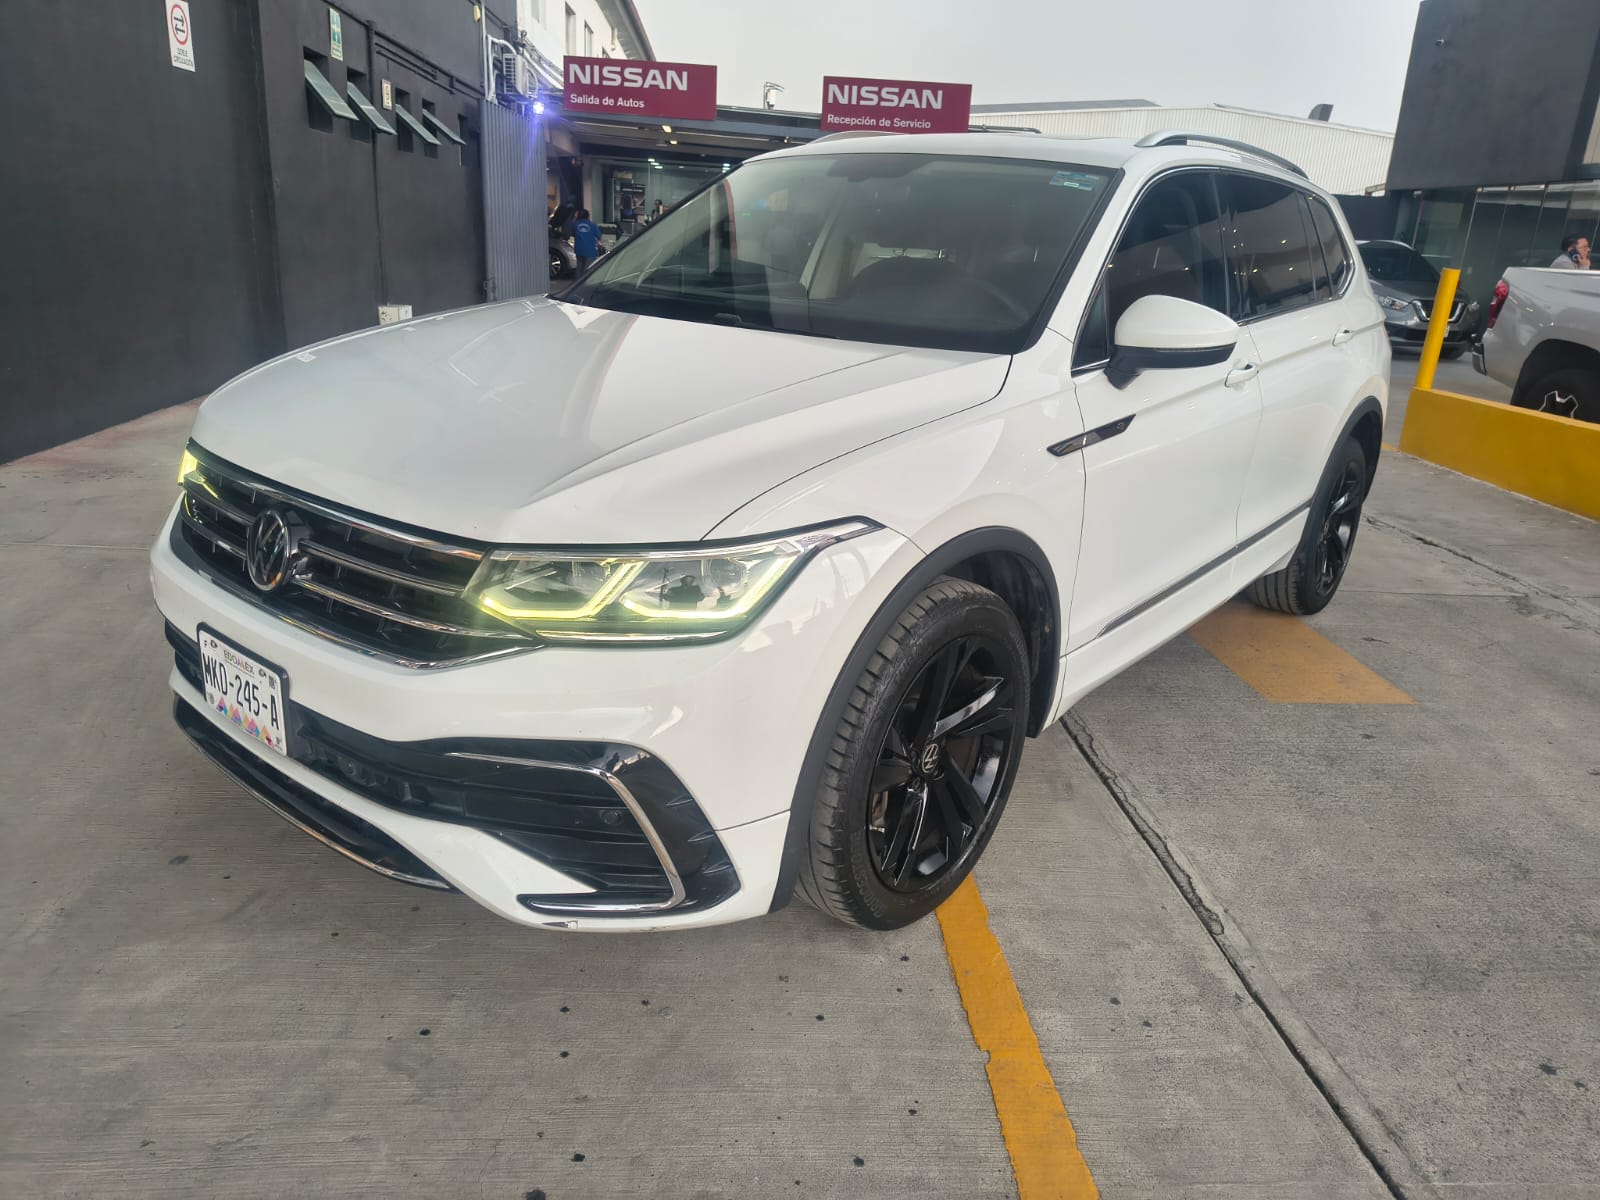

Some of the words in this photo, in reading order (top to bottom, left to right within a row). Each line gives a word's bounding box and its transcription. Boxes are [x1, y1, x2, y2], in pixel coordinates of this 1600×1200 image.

[569, 63, 688, 91] NISSAN
[570, 93, 600, 105] Salida
[602, 96, 615, 106] de
[617, 97, 645, 108] Autos
[827, 83, 943, 110] NISSAN
[827, 114, 876, 127] Recepción
[879, 117, 891, 127] de
[893, 117, 931, 129] Servicio
[202, 652, 280, 731] MKD-245-A
